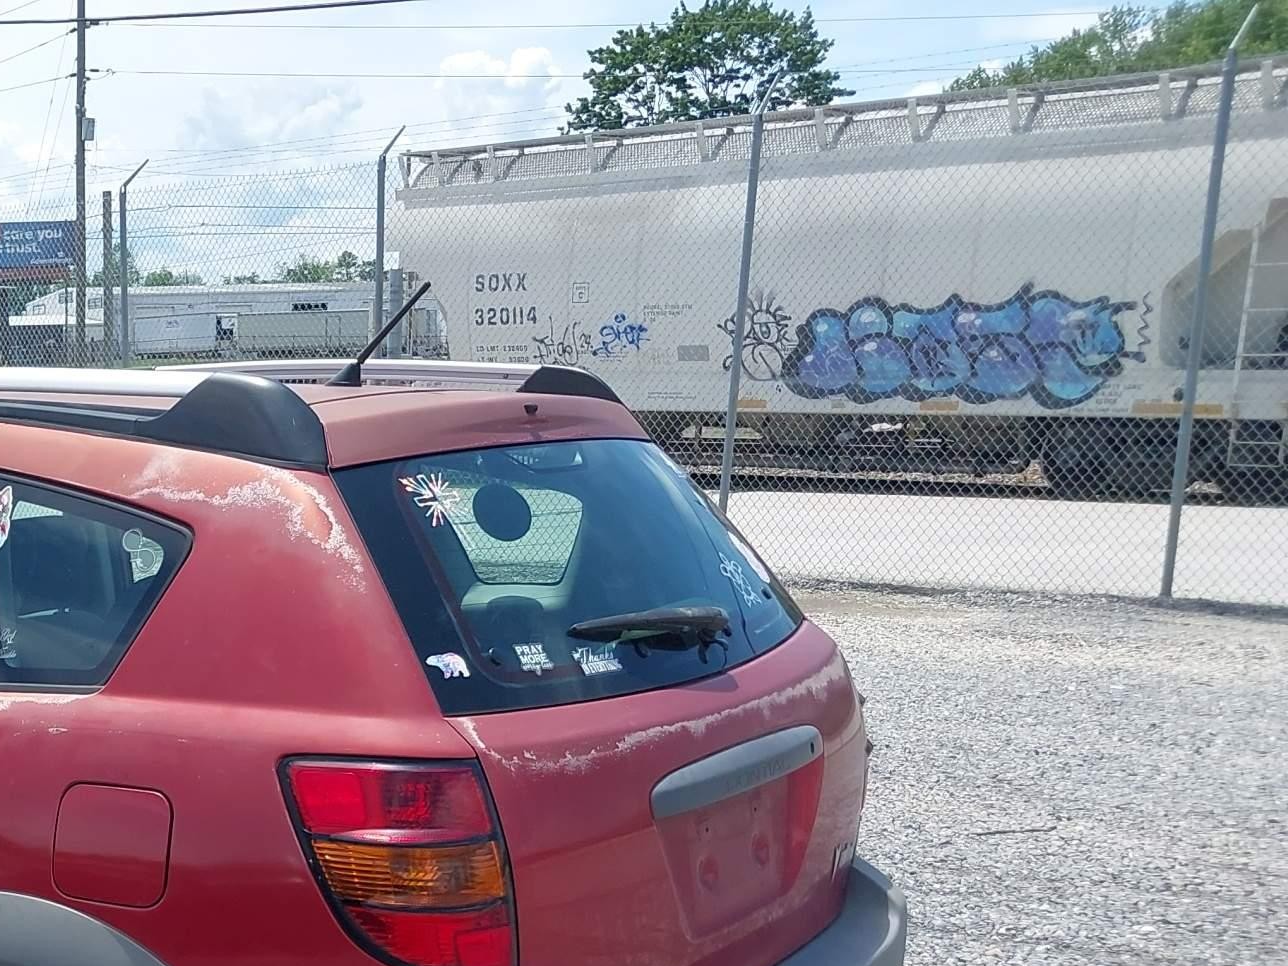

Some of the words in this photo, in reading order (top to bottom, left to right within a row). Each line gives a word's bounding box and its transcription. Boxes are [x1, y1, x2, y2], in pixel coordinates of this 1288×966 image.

[37, 228, 63, 241] you
[475, 272, 528, 293] SOXX
[474, 306, 537, 326] 320114
[514, 644, 544, 656] PRAY
[519, 653, 550, 664] MORE
